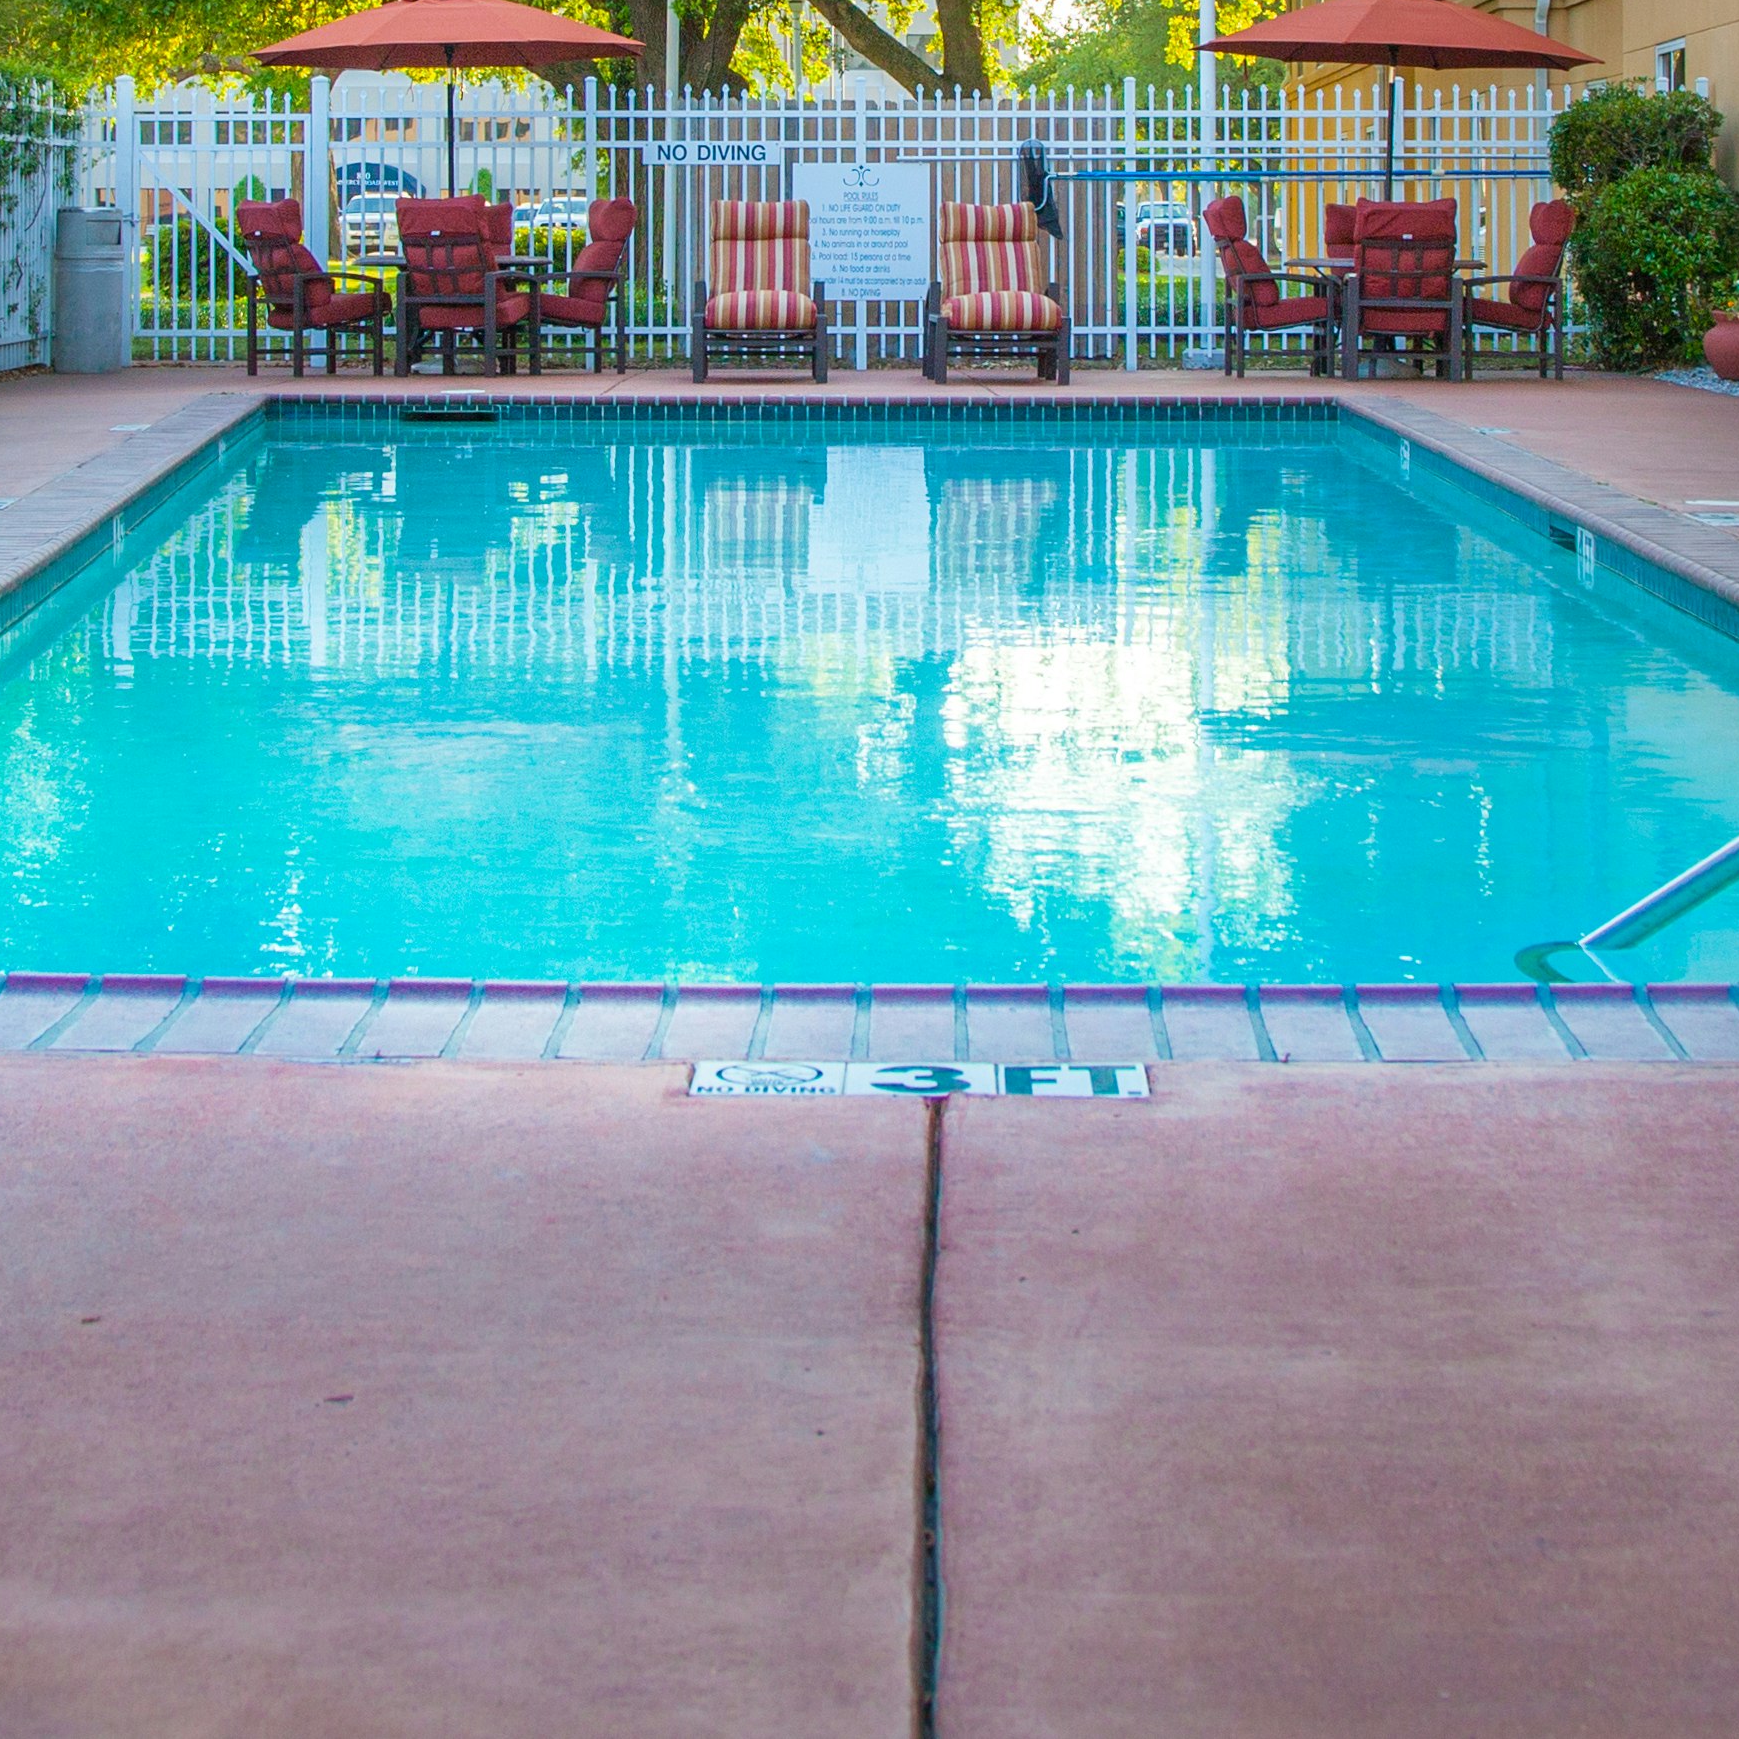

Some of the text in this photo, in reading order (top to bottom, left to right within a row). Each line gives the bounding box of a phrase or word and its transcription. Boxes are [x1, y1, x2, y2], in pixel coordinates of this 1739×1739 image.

[658, 145, 766, 161] NO DIVING
[844, 192, 878, 200] POOL RULES
[829, 204, 838, 212] NO
[840, 204, 850, 212] LIFE
[853, 204, 874, 212] GUARD
[875, 204, 885, 212] ON
[886, 204, 901, 212] DUTY
[819, 216, 835, 224] hours
[849, 216, 862, 224] from
[902, 216, 910, 224] 10
[829, 228, 838, 236] No
[840, 229, 862, 238] running
[871, 228, 901, 238] horseplay
[895, 241, 908, 249] pool
[839, 265, 848, 273] No
[850, 265, 864, 273] food
[873, 265, 890, 273] drinks
[860, 289, 882, 297] DIVING
[870, 1066, 972, 1094] 3
[697, 1086, 836, 1094] NO DIVING
